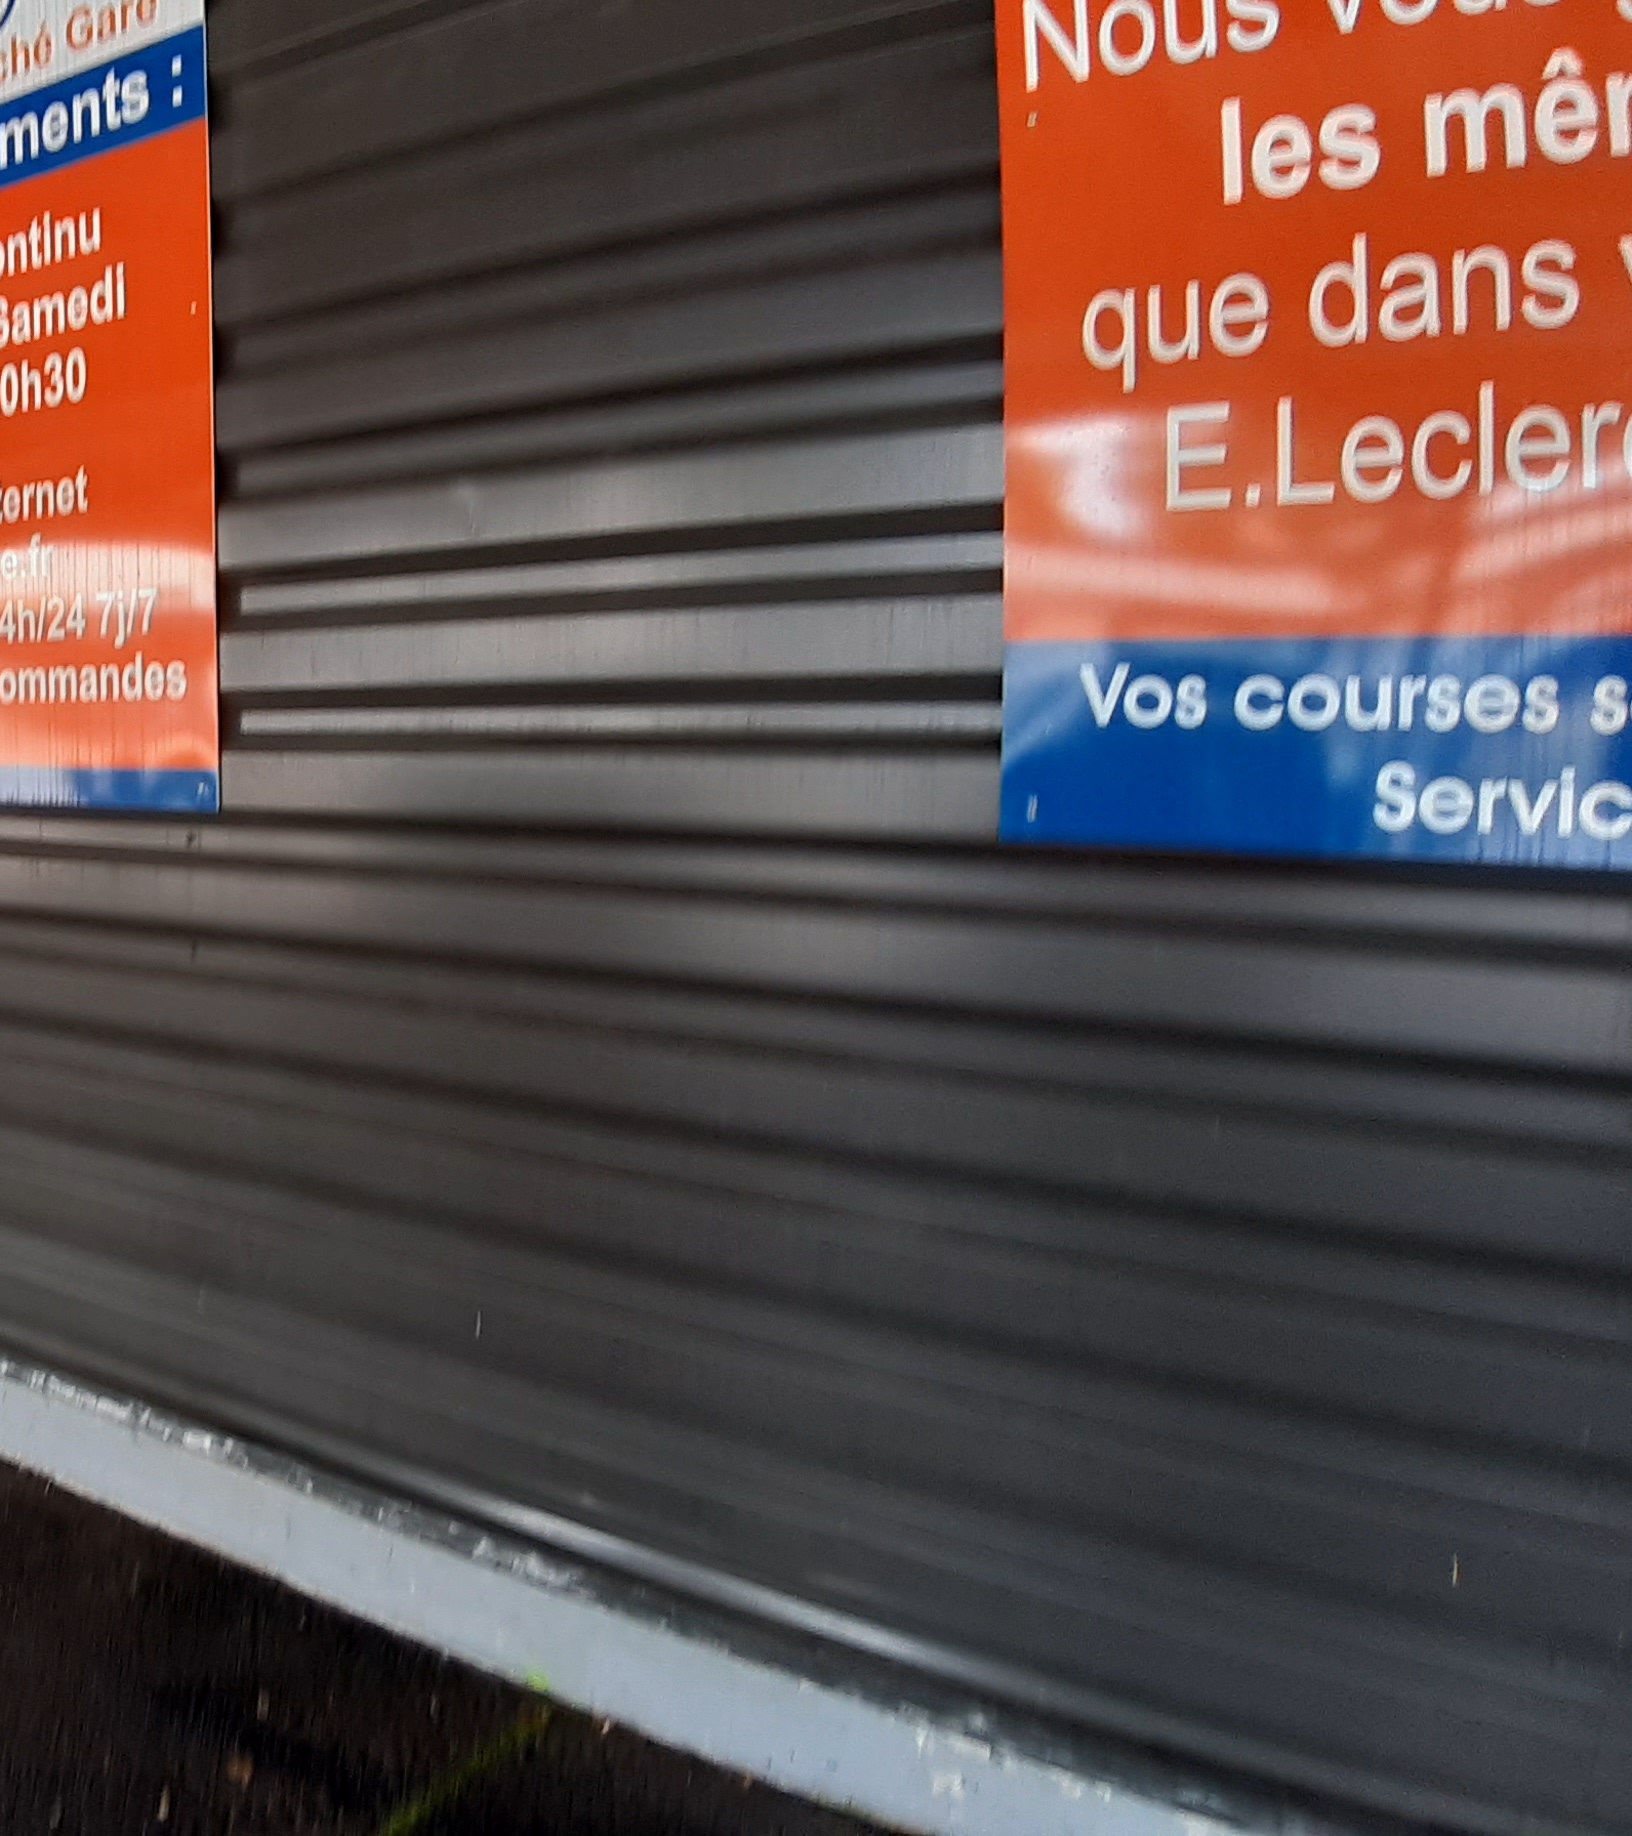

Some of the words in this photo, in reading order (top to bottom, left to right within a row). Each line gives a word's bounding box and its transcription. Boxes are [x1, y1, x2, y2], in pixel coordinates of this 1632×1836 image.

[66, 0, 158, 51] Gare
[1021, 0, 1280, 93] Nous
[1220, 96, 1381, 206] les
[1081, 271, 1269, 394] que
[1308, 231, 1580, 348] dans
[95, 586, 159, 650] 7j/7
[1079, 661, 1208, 732] Vos
[1234, 673, 1560, 735] courses
[1589, 674, 1632, 737] s
[1372, 759, 1632, 841] Servic
